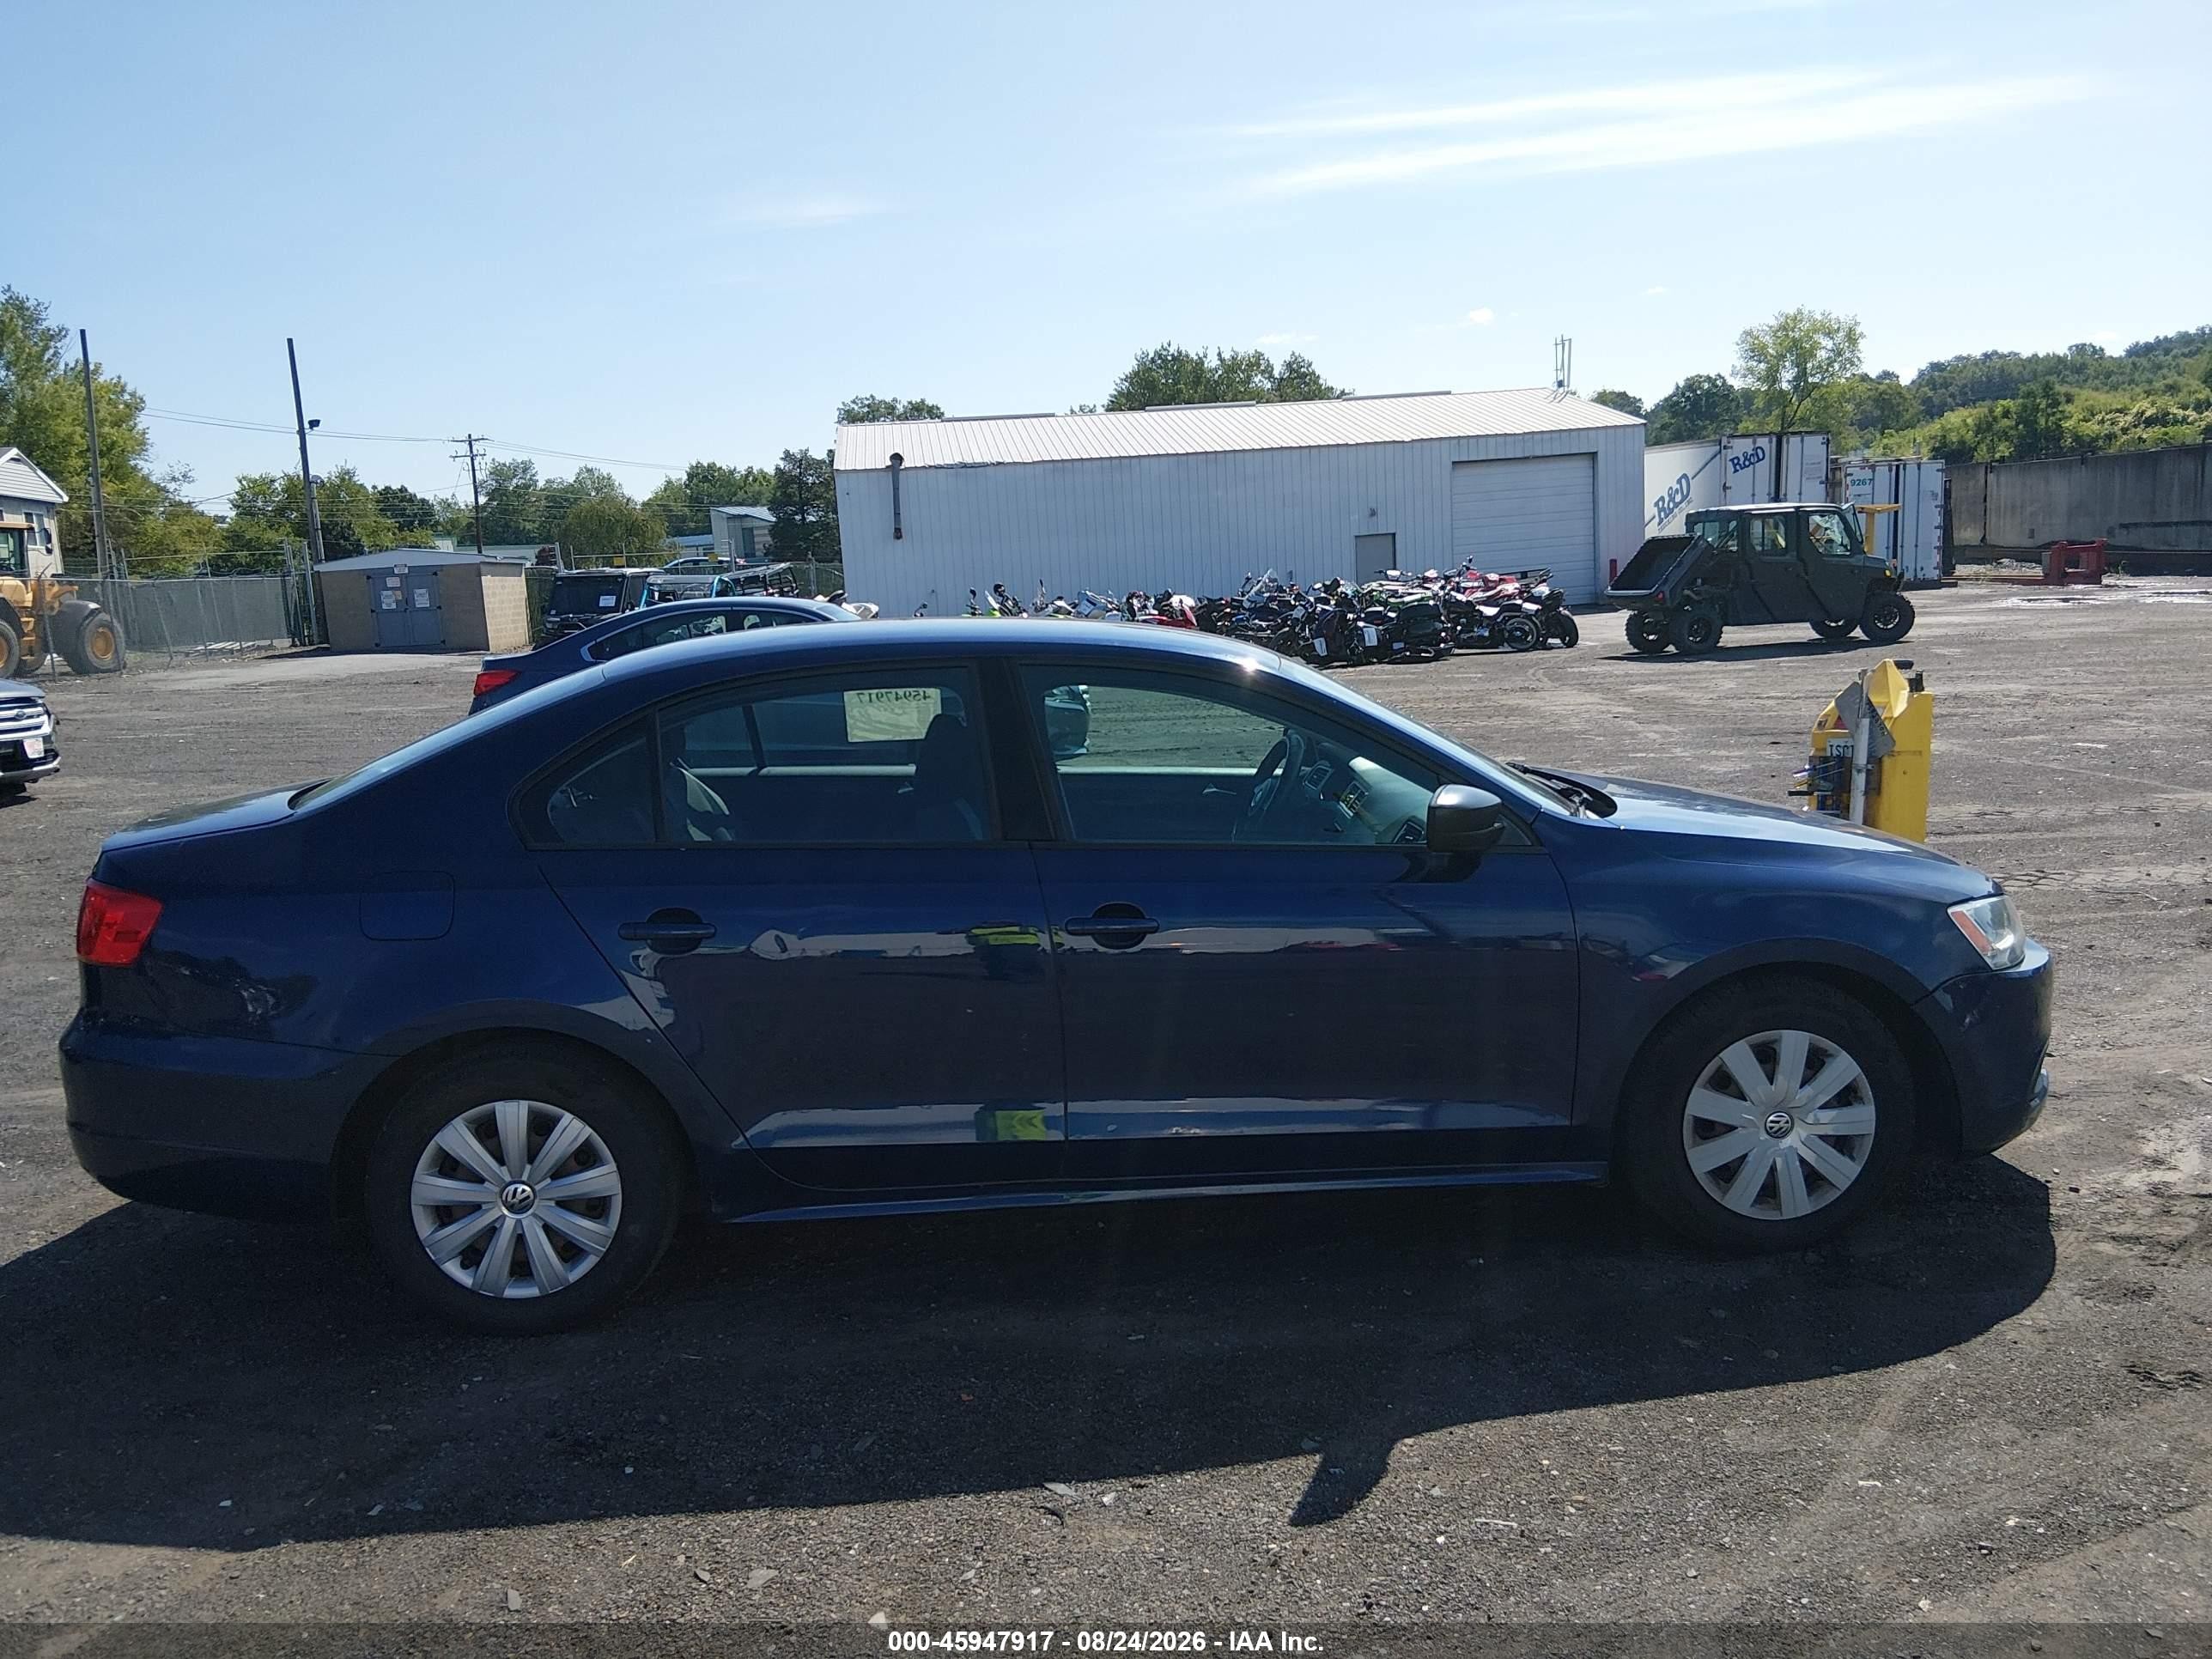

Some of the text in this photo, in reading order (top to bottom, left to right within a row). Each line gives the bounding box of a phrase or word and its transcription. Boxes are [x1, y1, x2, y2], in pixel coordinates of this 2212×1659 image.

[1729, 446, 1766, 474] R&D
[1850, 477, 1873, 487] 9267
[1653, 473, 1691, 526] R&D
